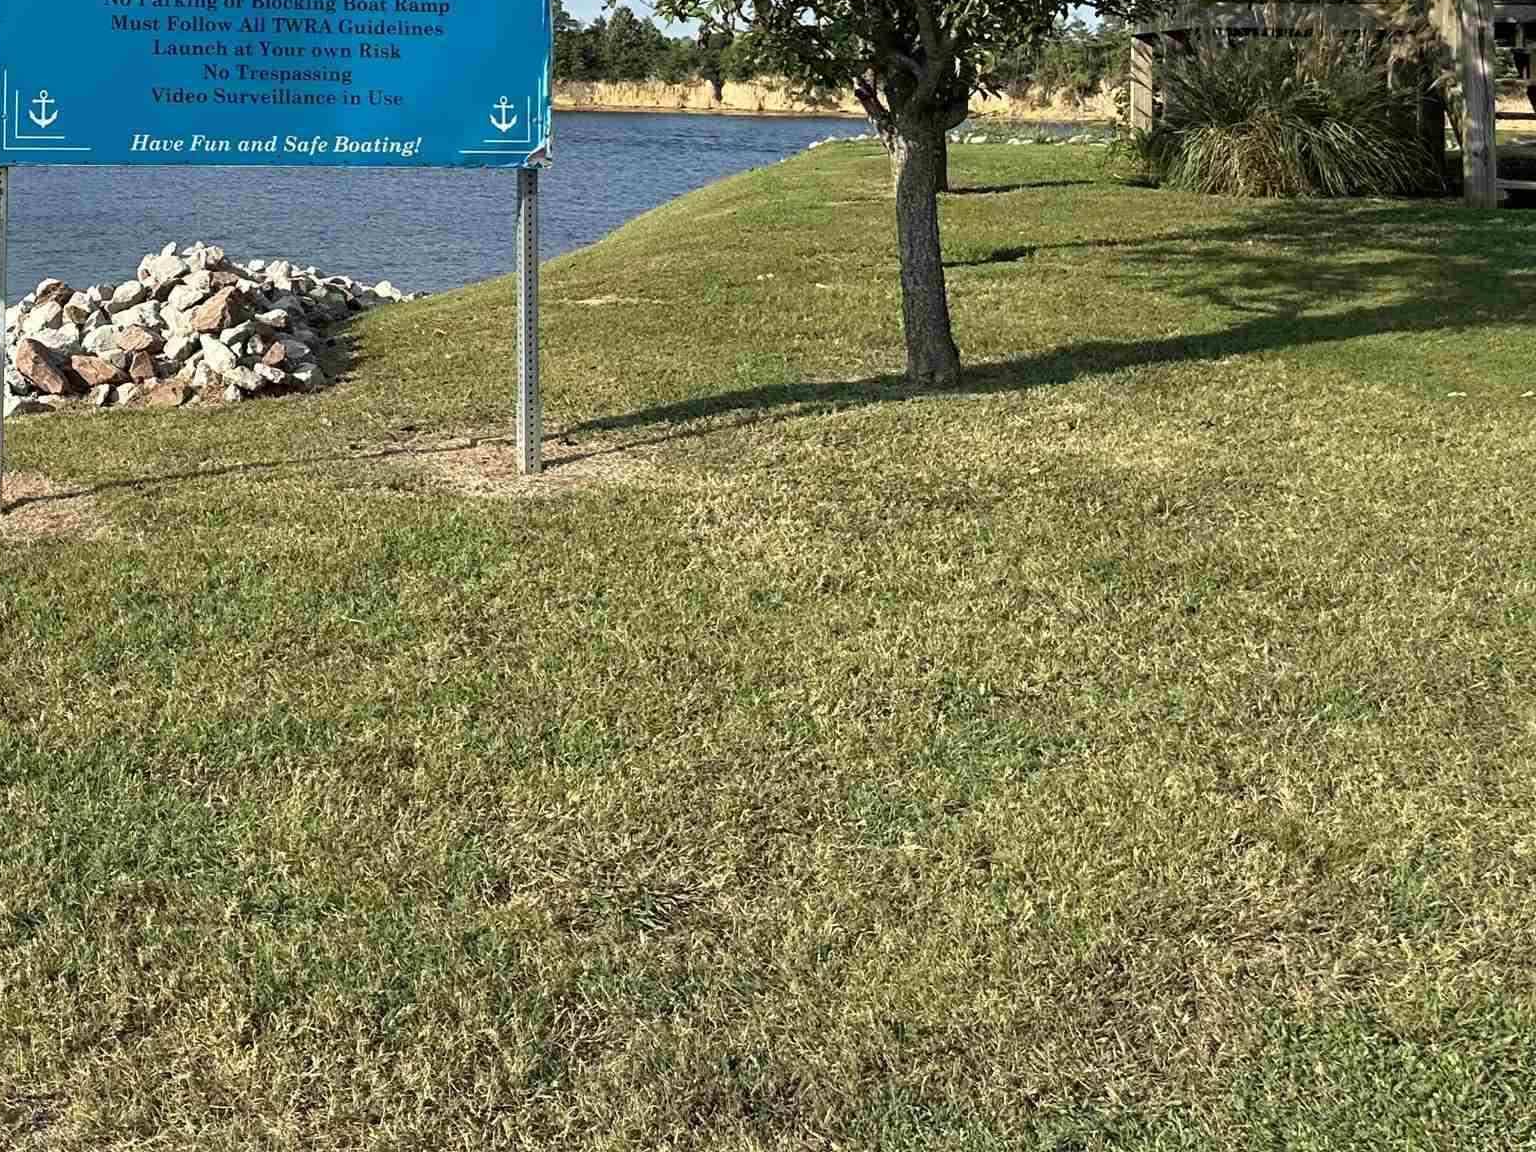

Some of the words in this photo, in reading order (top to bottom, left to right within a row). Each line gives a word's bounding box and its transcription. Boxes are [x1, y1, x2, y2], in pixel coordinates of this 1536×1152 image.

[111, 15, 160, 32] Must
[167, 16, 232, 33] Follow
[239, 17, 264, 34] All
[272, 17, 332, 35] TWRA
[338, 19, 444, 37] Guidelines
[152, 39, 227, 57] Launch
[234, 42, 253, 57] at
[259, 40, 305, 58] Your
[311, 46, 352, 58] own
[359, 42, 401, 60] Risk
[203, 64, 230, 81] No
[236, 65, 353, 85] Trespassing
[151, 87, 208, 104] Video
[214, 88, 336, 106] Surveillance
[343, 89, 361, 106] in
[368, 89, 403, 106] Use
[130, 134, 184, 152] Have
[189, 135, 230, 152] Fun
[238, 135, 277, 153] and
[283, 136, 328, 156] Safe
[333, 137, 423, 158] Boating!
